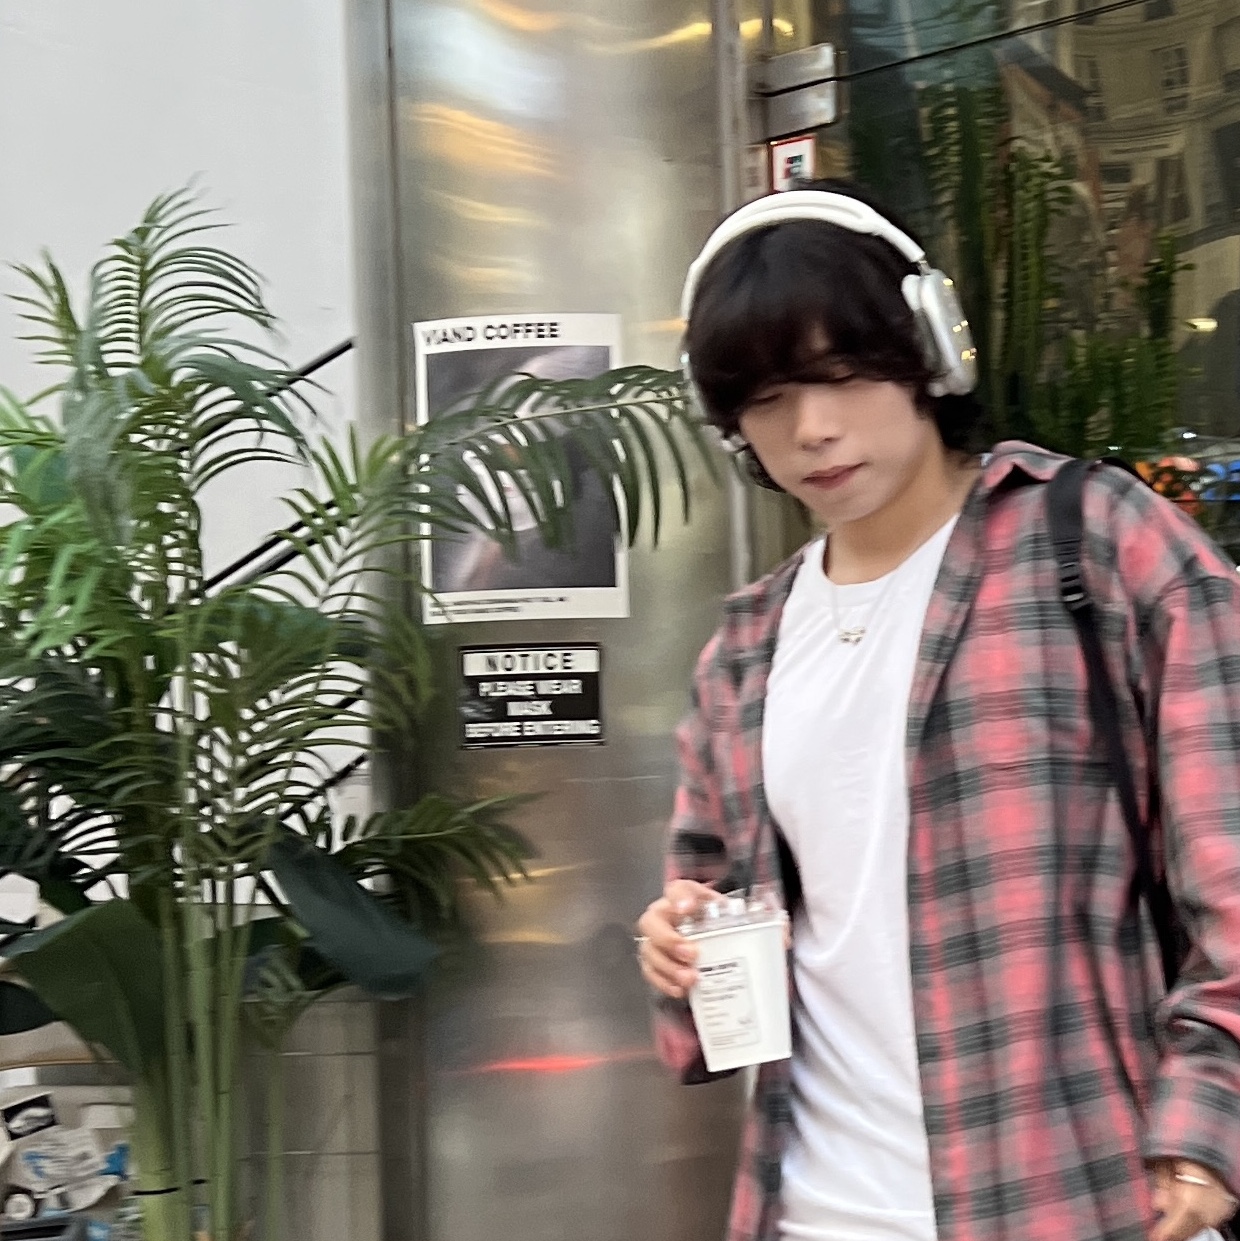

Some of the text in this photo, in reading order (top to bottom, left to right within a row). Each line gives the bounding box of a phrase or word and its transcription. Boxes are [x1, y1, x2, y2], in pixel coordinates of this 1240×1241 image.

[421, 321, 561, 346] VIAND COFFEE
[485, 652, 573, 672] NOTICE
